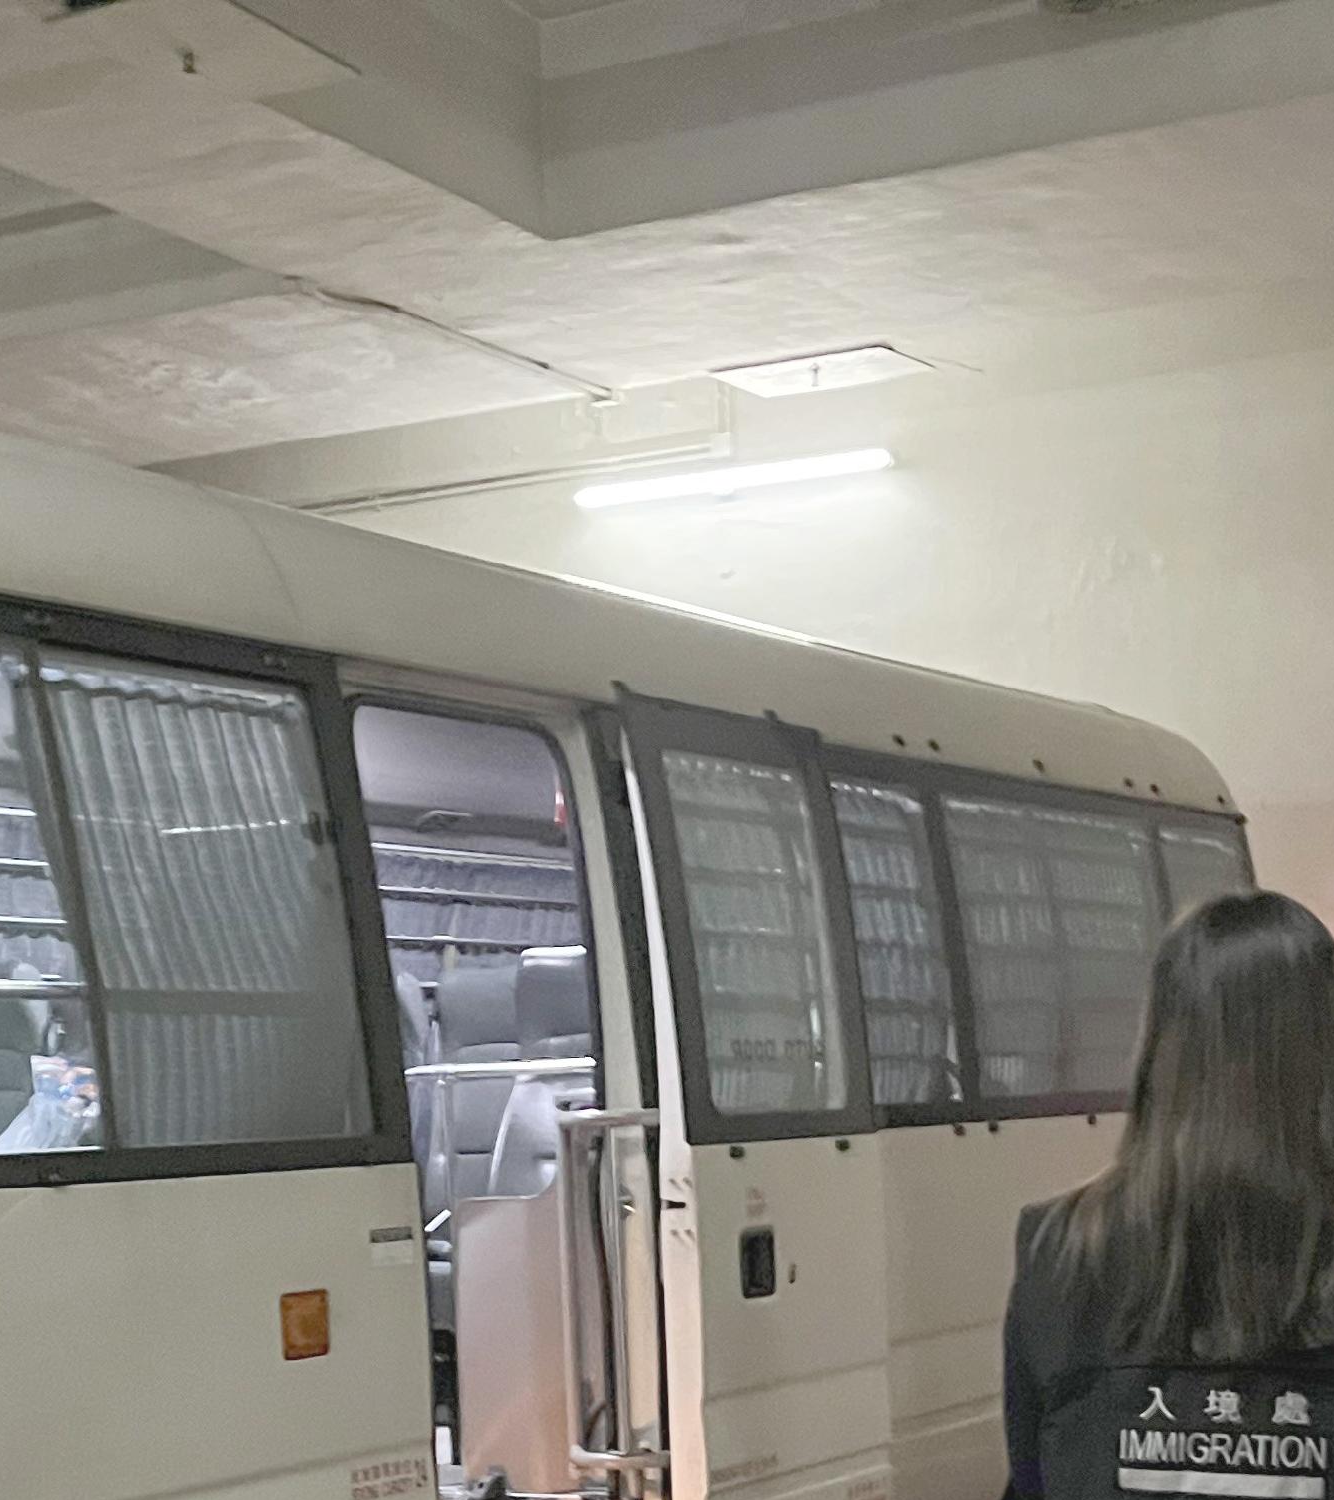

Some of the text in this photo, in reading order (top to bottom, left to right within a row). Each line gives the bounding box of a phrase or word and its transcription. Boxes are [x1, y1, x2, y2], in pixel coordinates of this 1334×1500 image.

[1139, 1386, 1312, 1426] 入境處
[1118, 1428, 1328, 1470] IMMIGRATION
